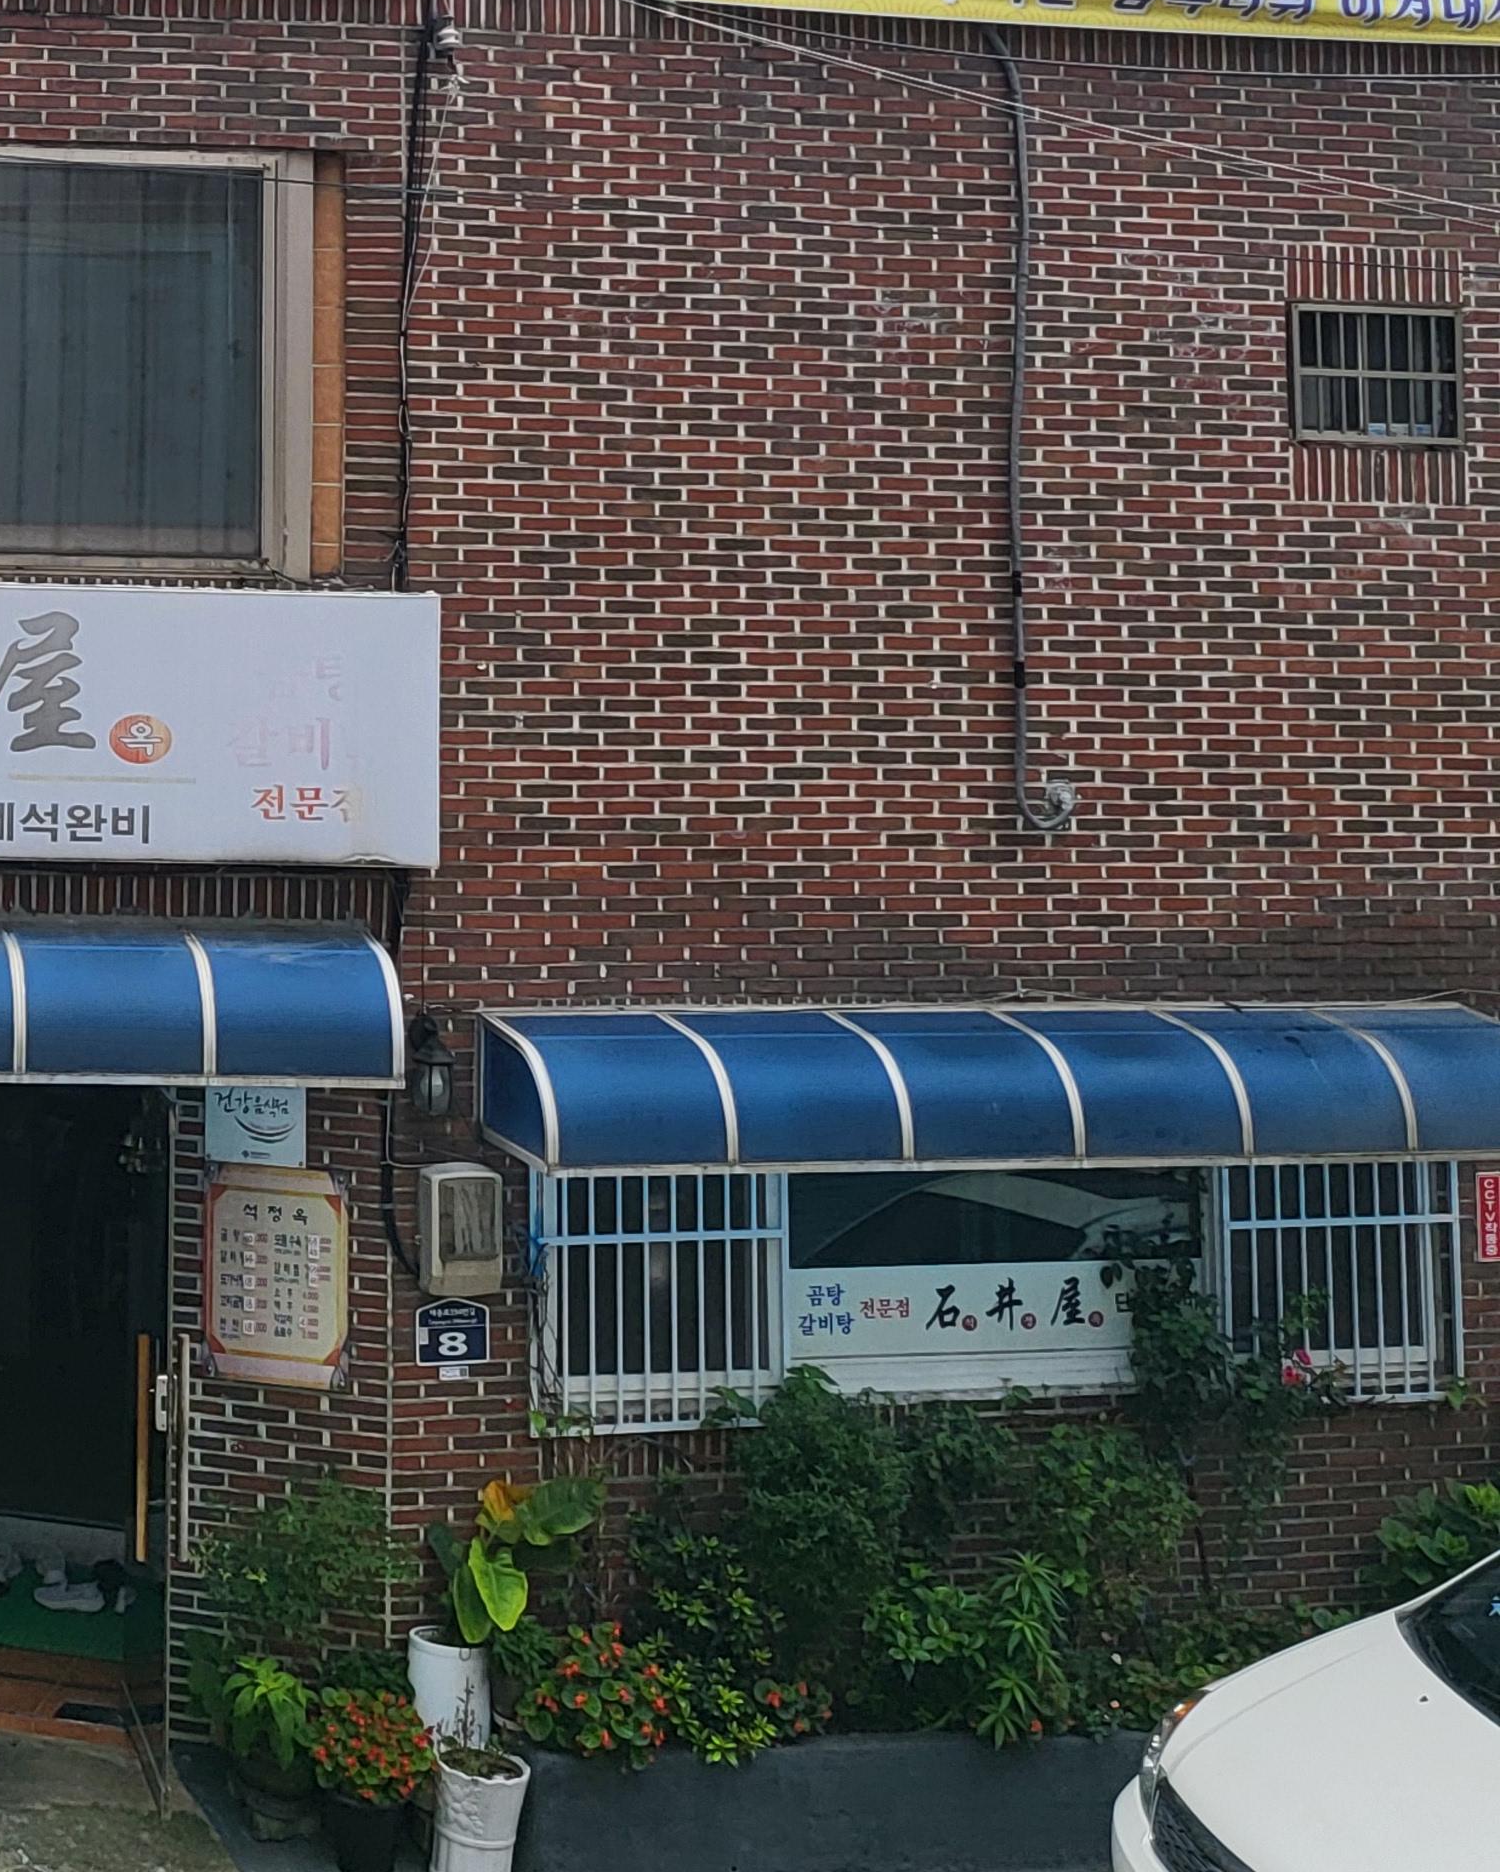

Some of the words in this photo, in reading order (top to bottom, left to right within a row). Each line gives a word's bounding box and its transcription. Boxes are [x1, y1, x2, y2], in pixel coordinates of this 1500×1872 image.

[118, 719, 163, 757] 옥
[213, 1087, 290, 1119] 건강음식점
[806, 1282, 847, 1307] 곰탕
[860, 1296, 910, 1319] 전문점
[798, 1311, 856, 1337] 갈비탕
[438, 1331, 468, 1357] 8
